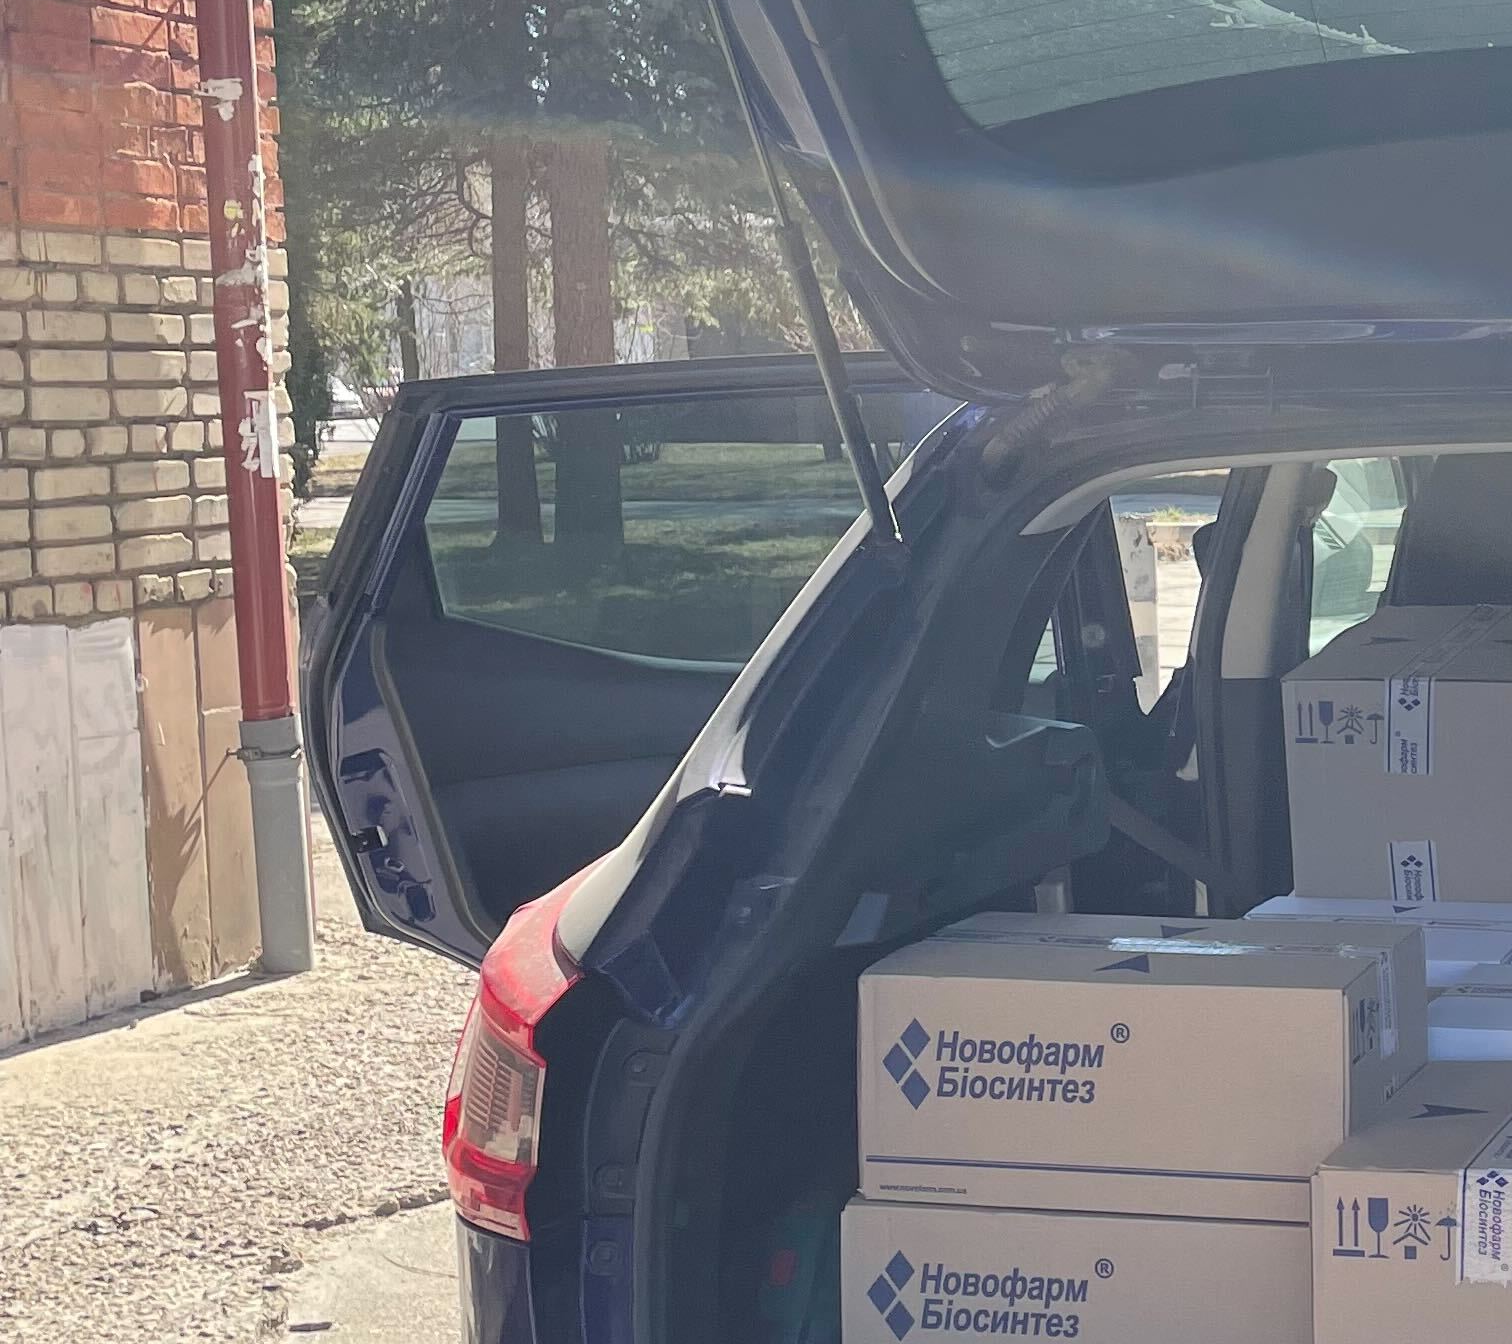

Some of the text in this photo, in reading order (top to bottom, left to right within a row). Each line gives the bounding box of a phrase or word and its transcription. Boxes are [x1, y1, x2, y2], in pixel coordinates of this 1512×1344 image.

[936, 1030, 1104, 1074] Новофарм
[937, 1066, 1095, 1103] Біосинтез
[1478, 1189, 1492, 1256] Біосинтез
[1489, 1189, 1506, 1261] Новофарм
[920, 1263, 1088, 1309] Новофарм
[921, 1298, 1079, 1338] Біосинтез
